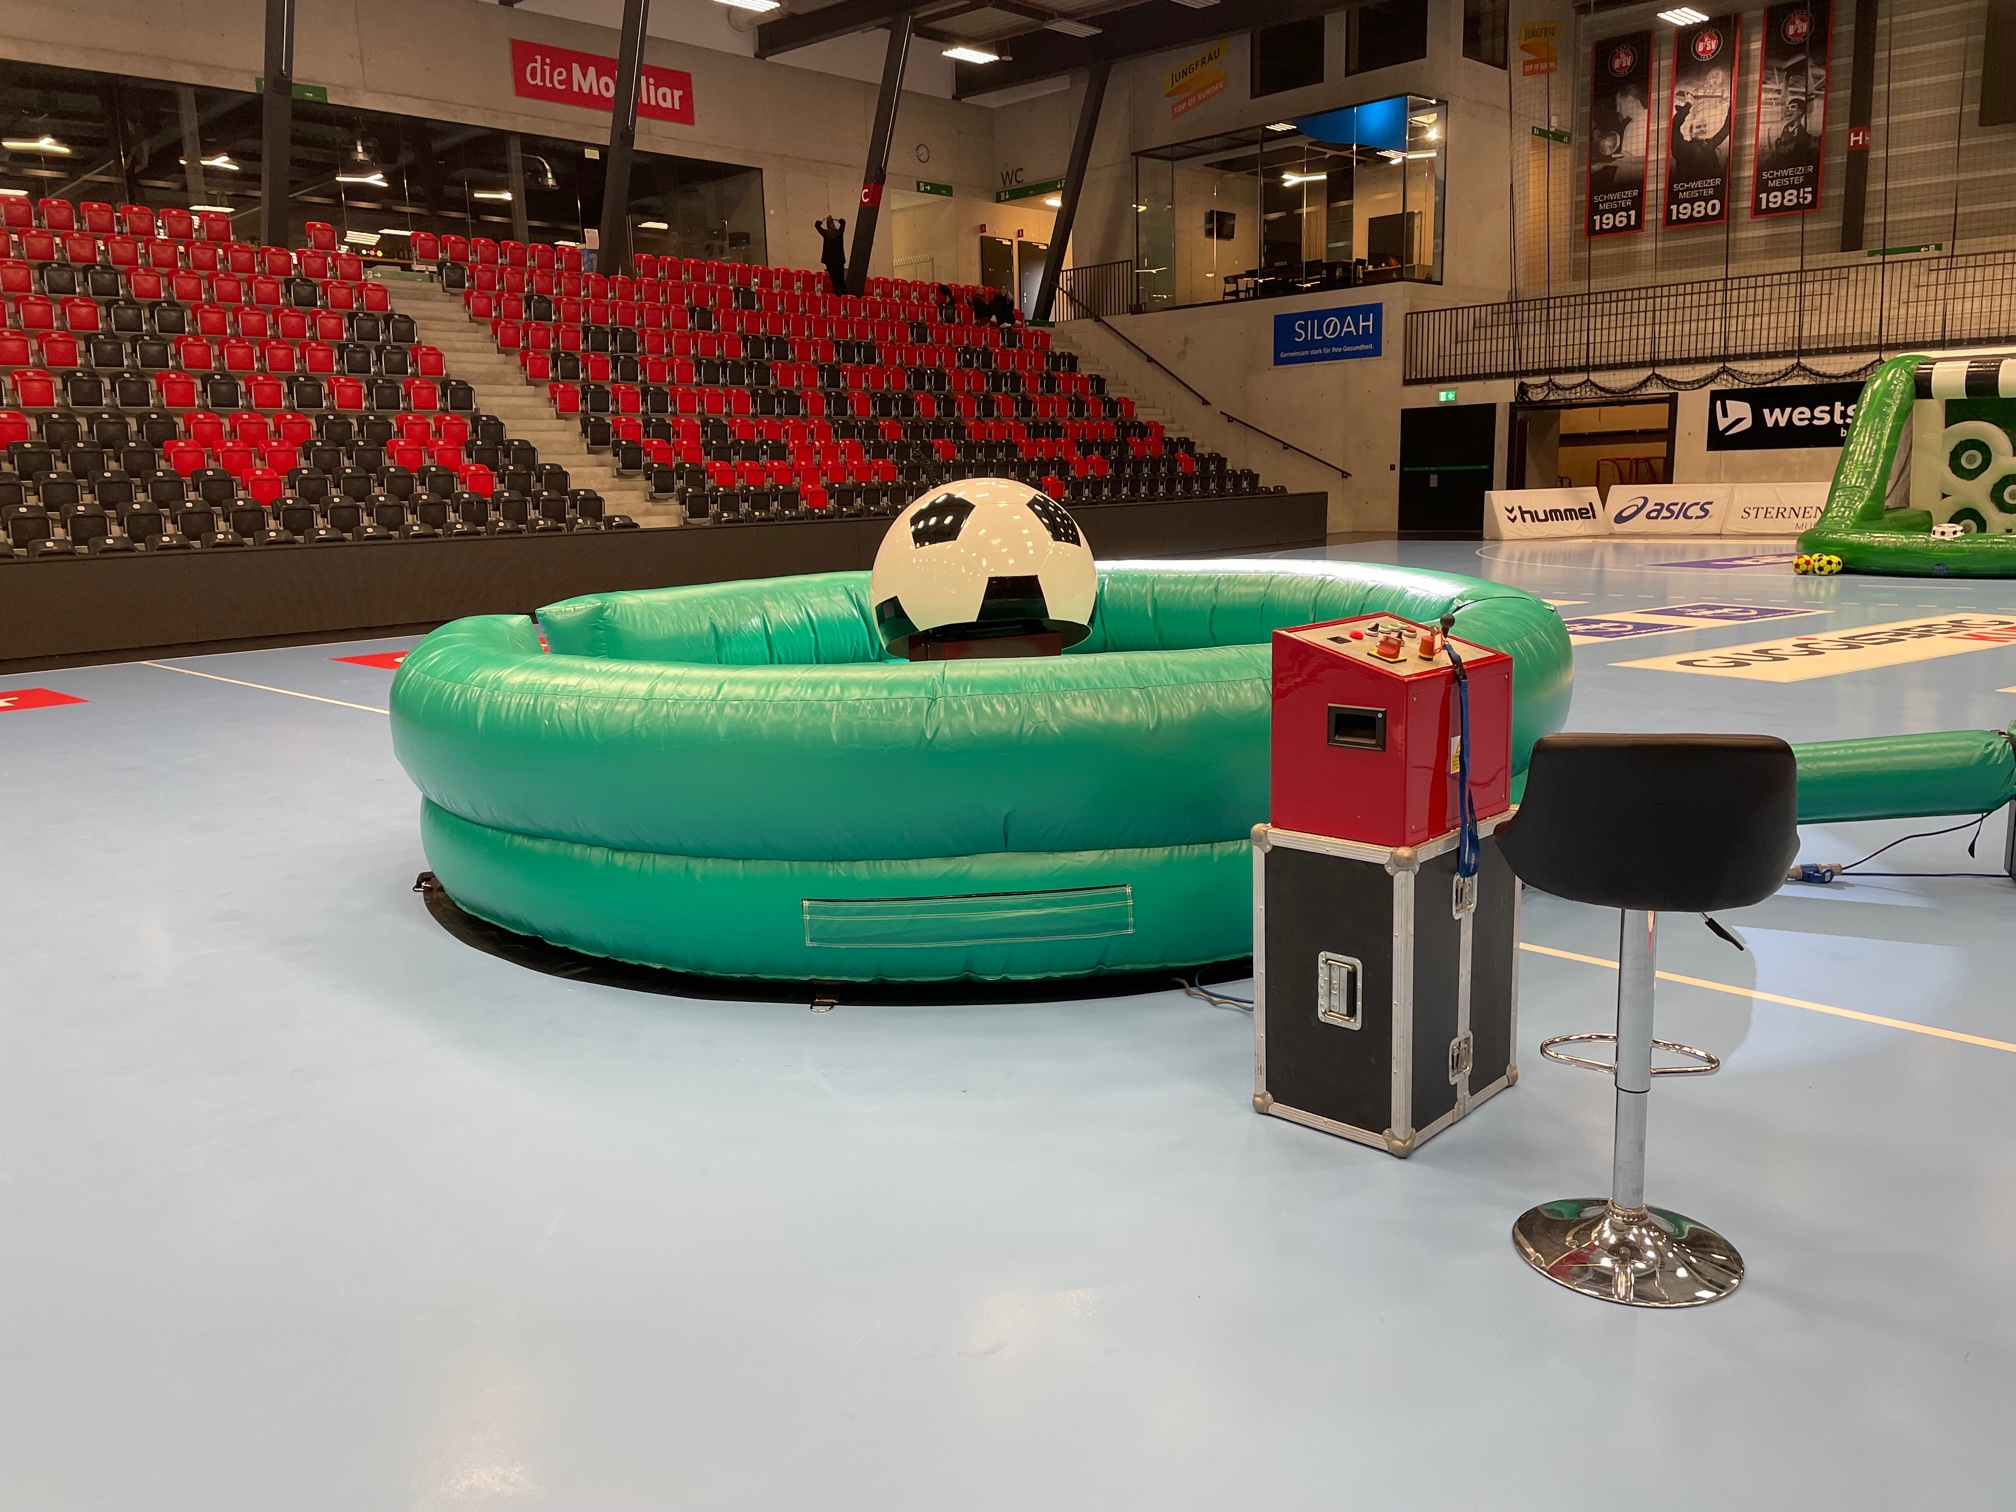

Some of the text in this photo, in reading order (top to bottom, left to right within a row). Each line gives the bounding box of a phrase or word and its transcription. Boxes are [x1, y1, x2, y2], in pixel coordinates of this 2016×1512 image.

[1171, 48, 1220, 88] JUNGFRAU
[526, 55, 683, 110] die Moliar
[1173, 81, 1224, 115] TOP OF EUROPE
[1850, 131, 1863, 146] H
[1000, 168, 1024, 186] WC
[1762, 165, 1814, 179] SCHWEIZER
[1673, 178, 1722, 191] SCHWEIZER
[1678, 188, 1714, 199] MEISTER
[861, 188, 870, 202] C
[1593, 189, 1639, 203] SCHWEIZER
[1759, 187, 1813, 210] 1985
[1599, 199, 1632, 210] MEISTER
[1670, 199, 1721, 220] 1980
[1593, 210, 1636, 231] 1961
[1280, 350, 1309, 358] Gemeinsam
[1323, 346, 1331, 354] für
[1518, 502, 1597, 523] hummel
[1676, 619, 2015, 668] GUGGISBERG
